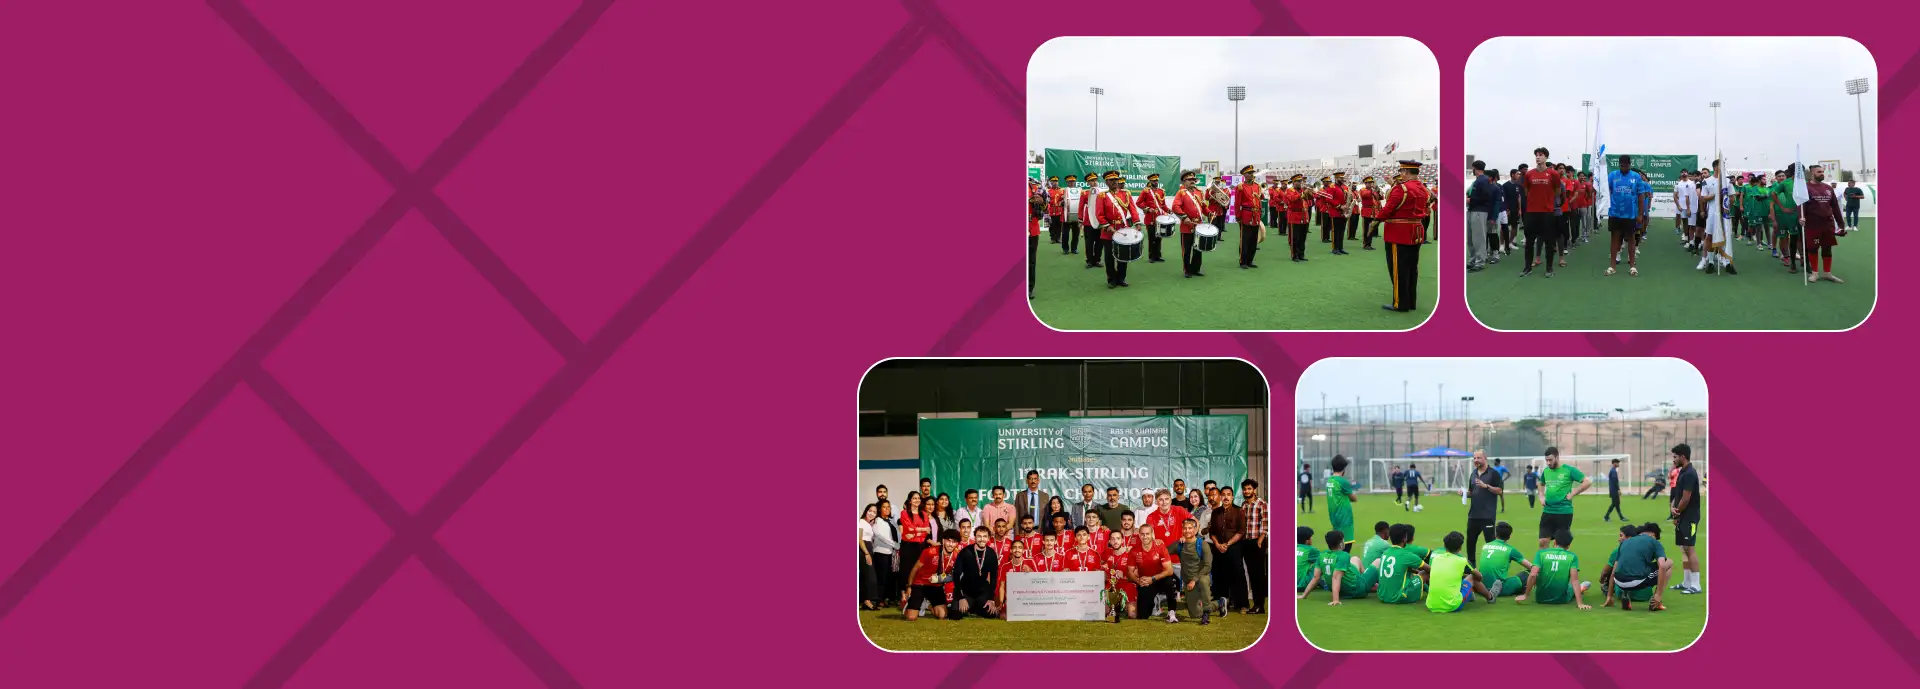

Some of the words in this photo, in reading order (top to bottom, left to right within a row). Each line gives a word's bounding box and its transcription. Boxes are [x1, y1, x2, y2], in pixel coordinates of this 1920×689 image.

[998, 428, 1054, 436] UNIVERSITY
[1055, 427, 1064, 436] of
[998, 437, 1064, 449] STIRLING
[1110, 437, 1168, 448] CAMPUS
[1038, 467, 1148, 479] RAK-STIRLING
[1486, 550, 1494, 558] 7
[1379, 555, 1396, 578] 13
[1551, 561, 1559, 571] 11
